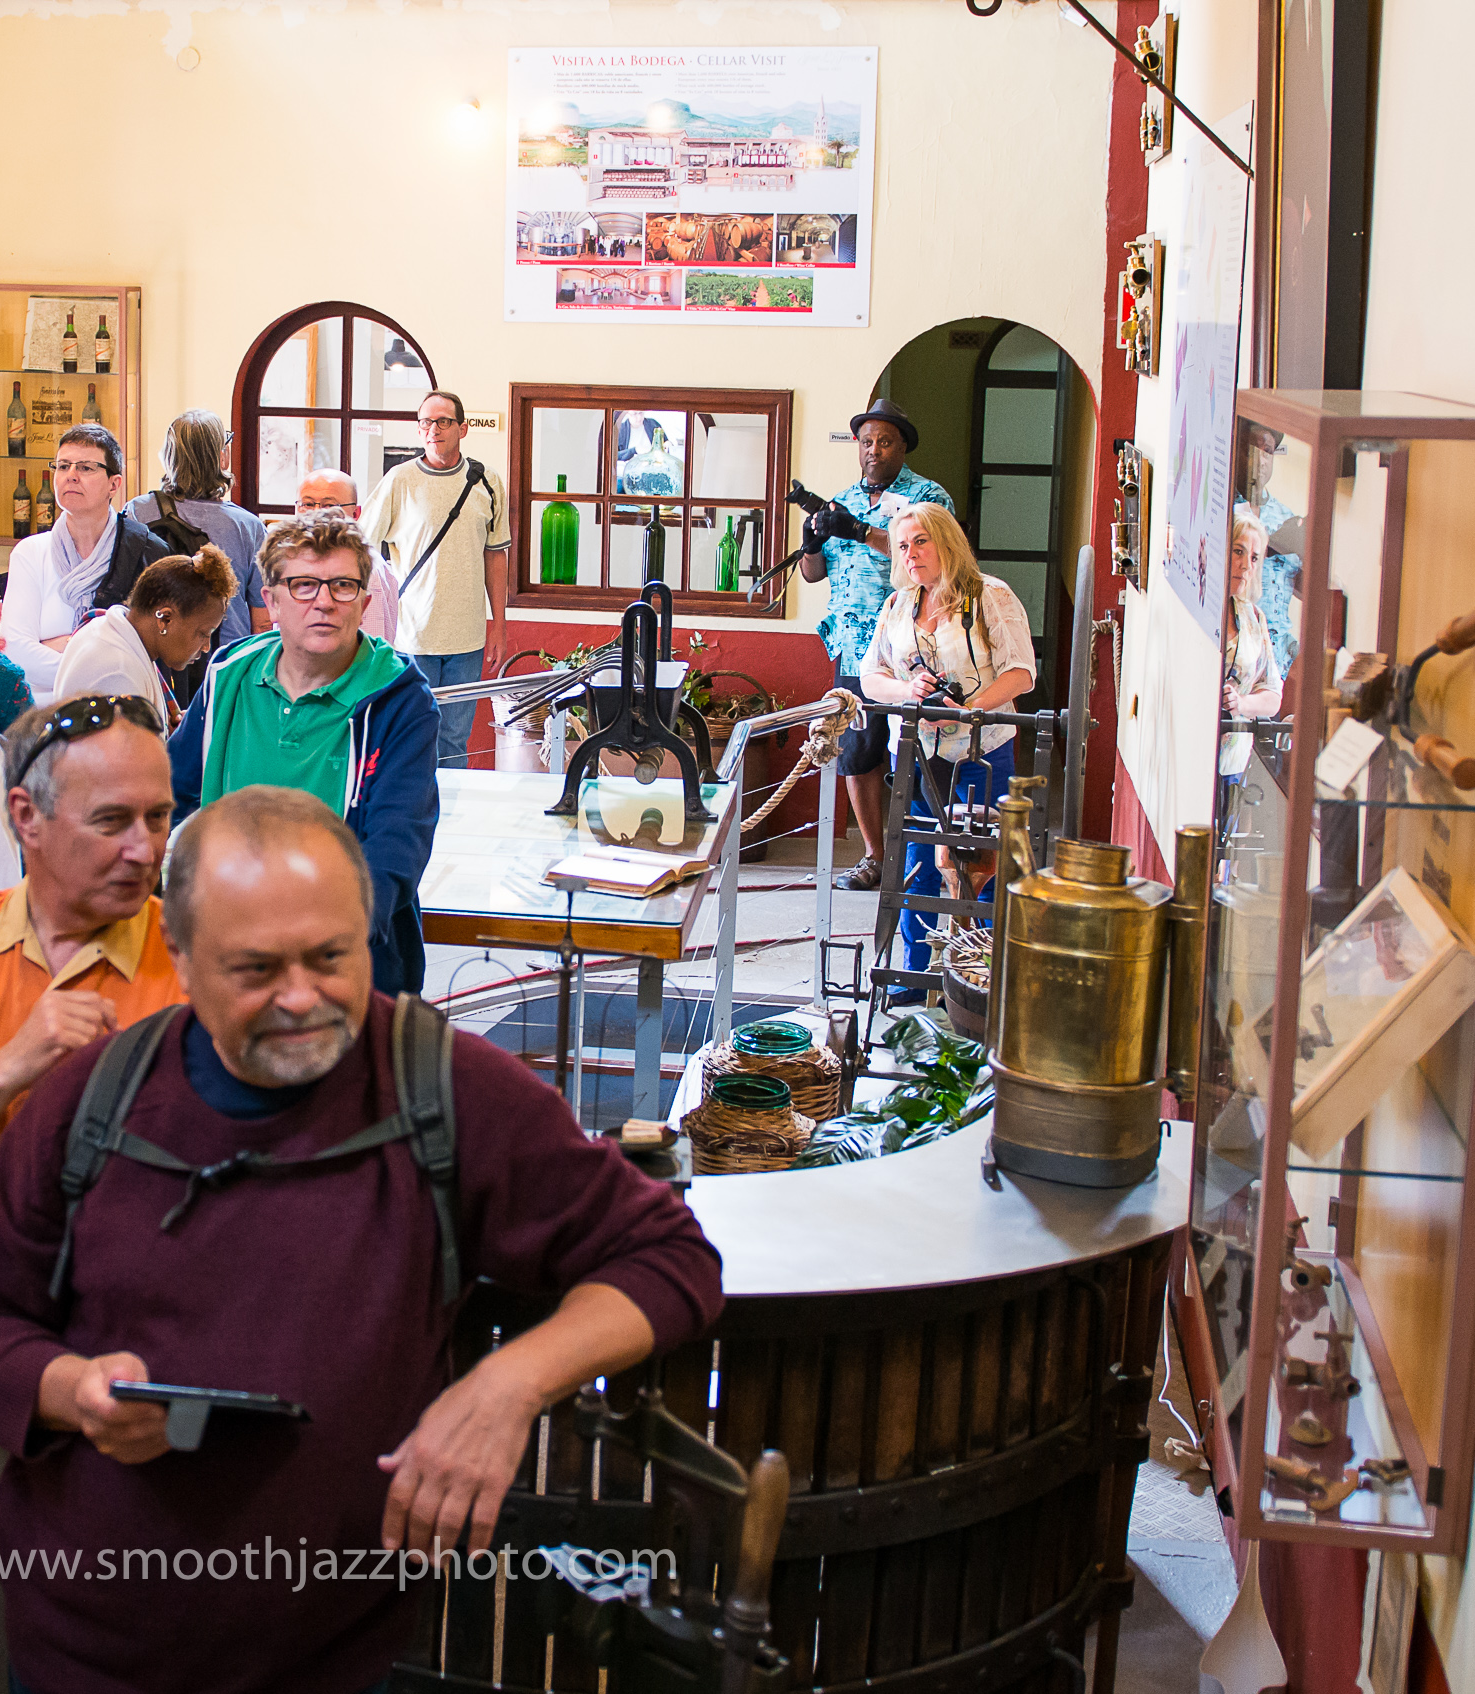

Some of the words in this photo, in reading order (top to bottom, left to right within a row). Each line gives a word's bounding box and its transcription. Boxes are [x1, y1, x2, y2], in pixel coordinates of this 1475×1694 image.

[552, 55, 594, 66] VISITA
[597, 56, 606, 66] A
[611, 56, 625, 66] LA
[631, 55, 685, 66] BODEGA
[697, 54, 747, 66] CELLAR
[751, 54, 786, 66] VISIT
[466, 418, 496, 428] ICINAS
